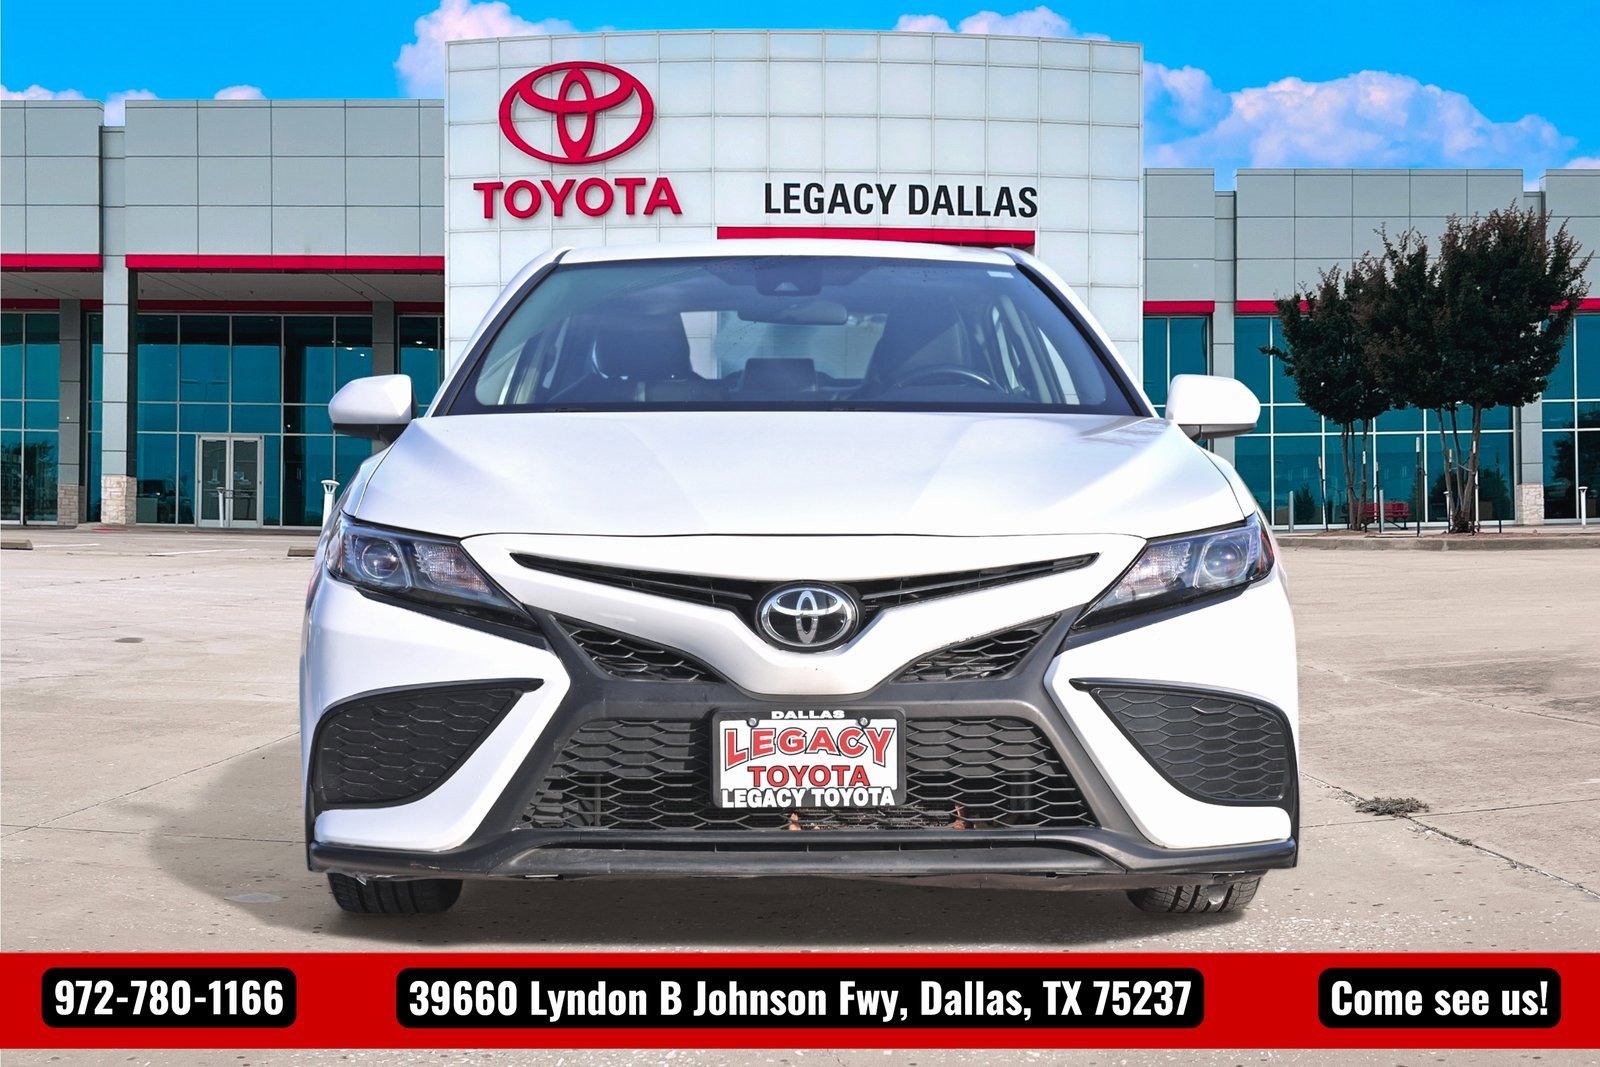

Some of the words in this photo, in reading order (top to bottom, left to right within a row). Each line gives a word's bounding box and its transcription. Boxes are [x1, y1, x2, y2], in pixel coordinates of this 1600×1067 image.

[473, 176, 682, 220] TOYOTA
[764, 182, 897, 215] LEGACY
[908, 184, 1038, 218] DALLAS
[771, 710, 845, 720] DALLAS
[725, 727, 896, 771] LEGACY
[747, 765, 871, 787] TOYOTA
[721, 788, 806, 808] LEGACY
[811, 787, 896, 808] TOYOTA
